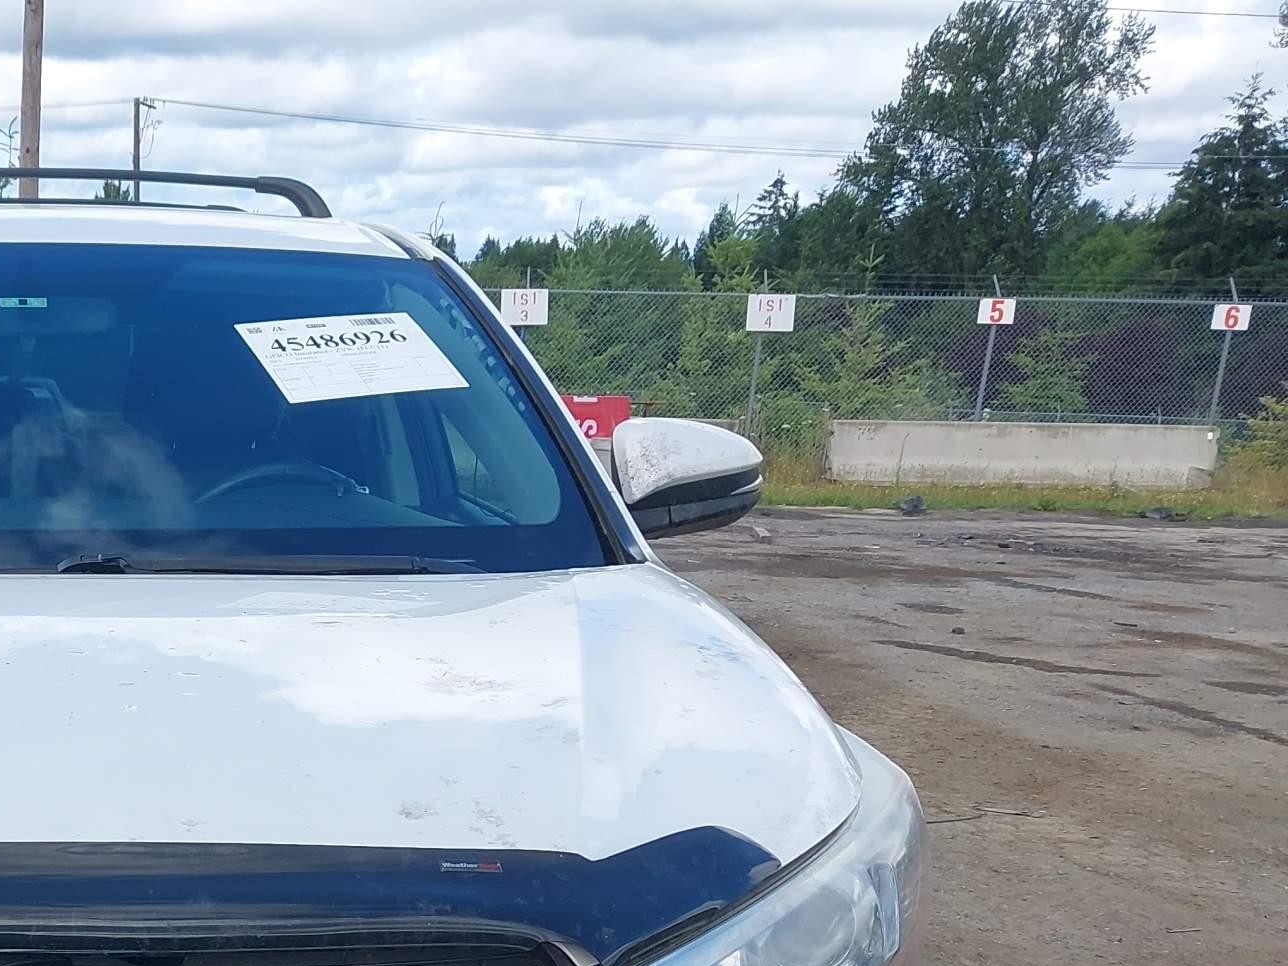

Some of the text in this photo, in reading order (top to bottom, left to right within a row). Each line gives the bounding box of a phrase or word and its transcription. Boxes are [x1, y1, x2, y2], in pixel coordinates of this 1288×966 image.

[520, 309, 528, 322] 3
[764, 315, 772, 329] 4
[989, 300, 1005, 323] 5
[1223, 305, 1240, 329] 6
[269, 328, 408, 353] 45486926
